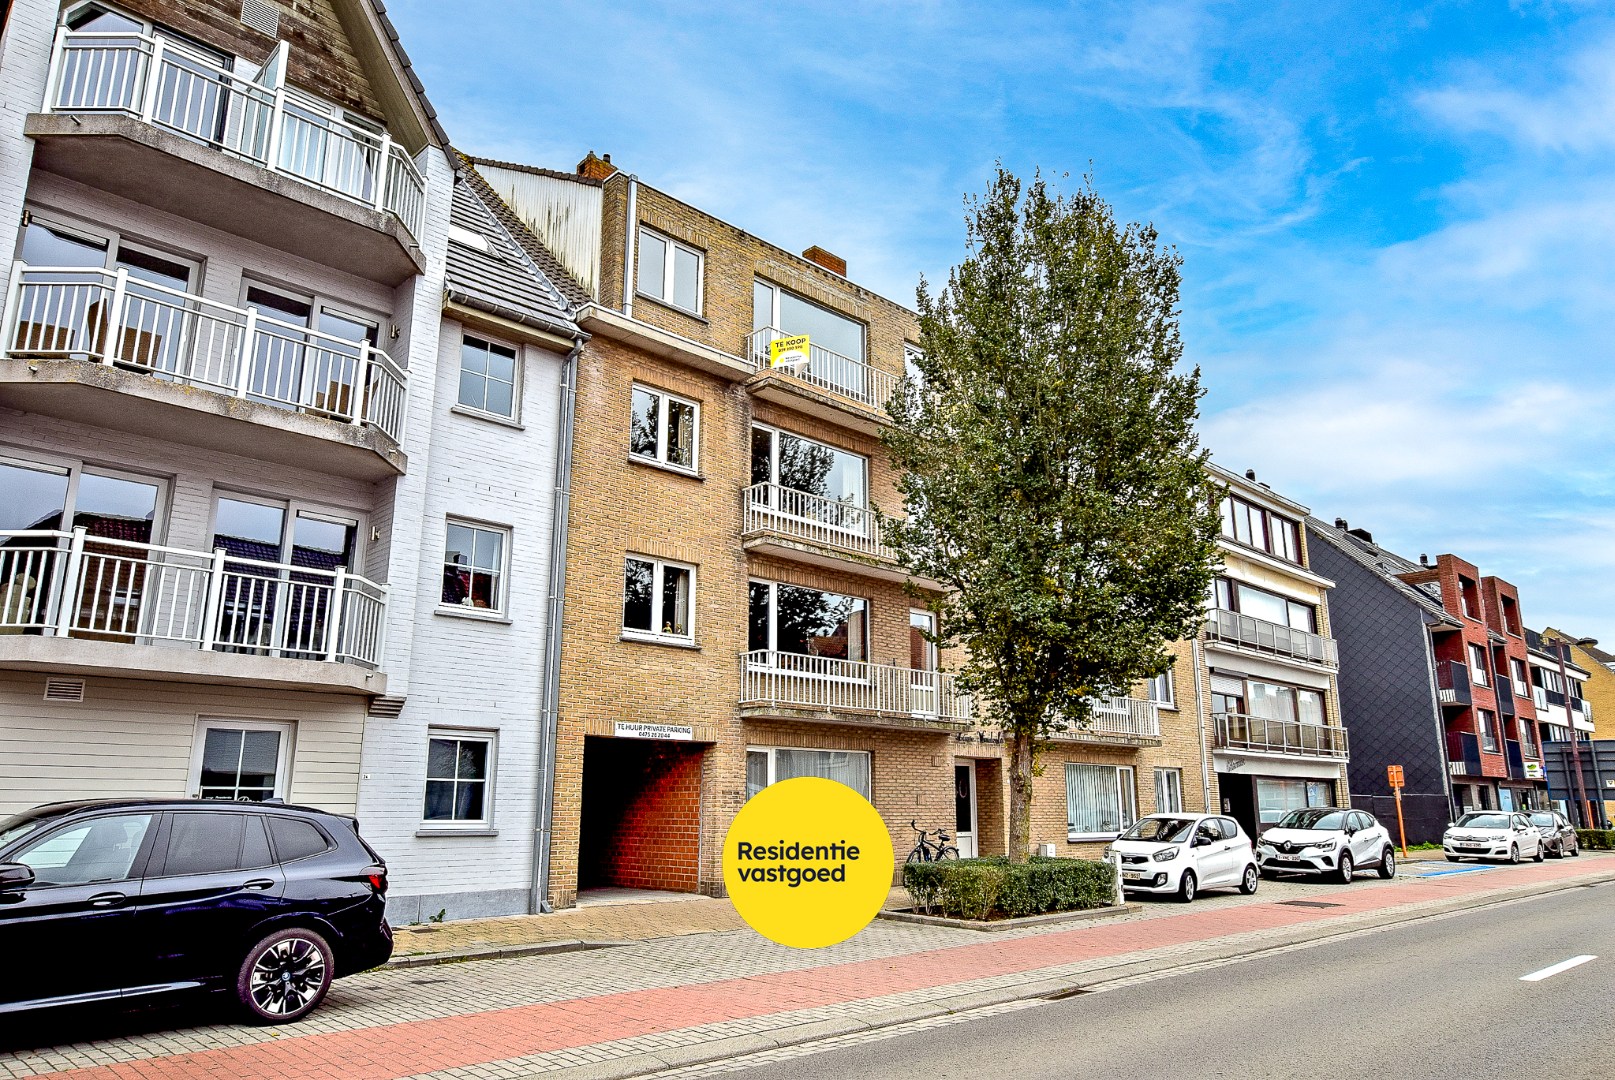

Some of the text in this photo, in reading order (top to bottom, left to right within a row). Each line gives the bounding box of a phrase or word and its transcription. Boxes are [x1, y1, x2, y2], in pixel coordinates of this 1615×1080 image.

[786, 338, 806, 346] KOOP
[617, 723, 691, 734] TE HUUR PRIVATE PARKING
